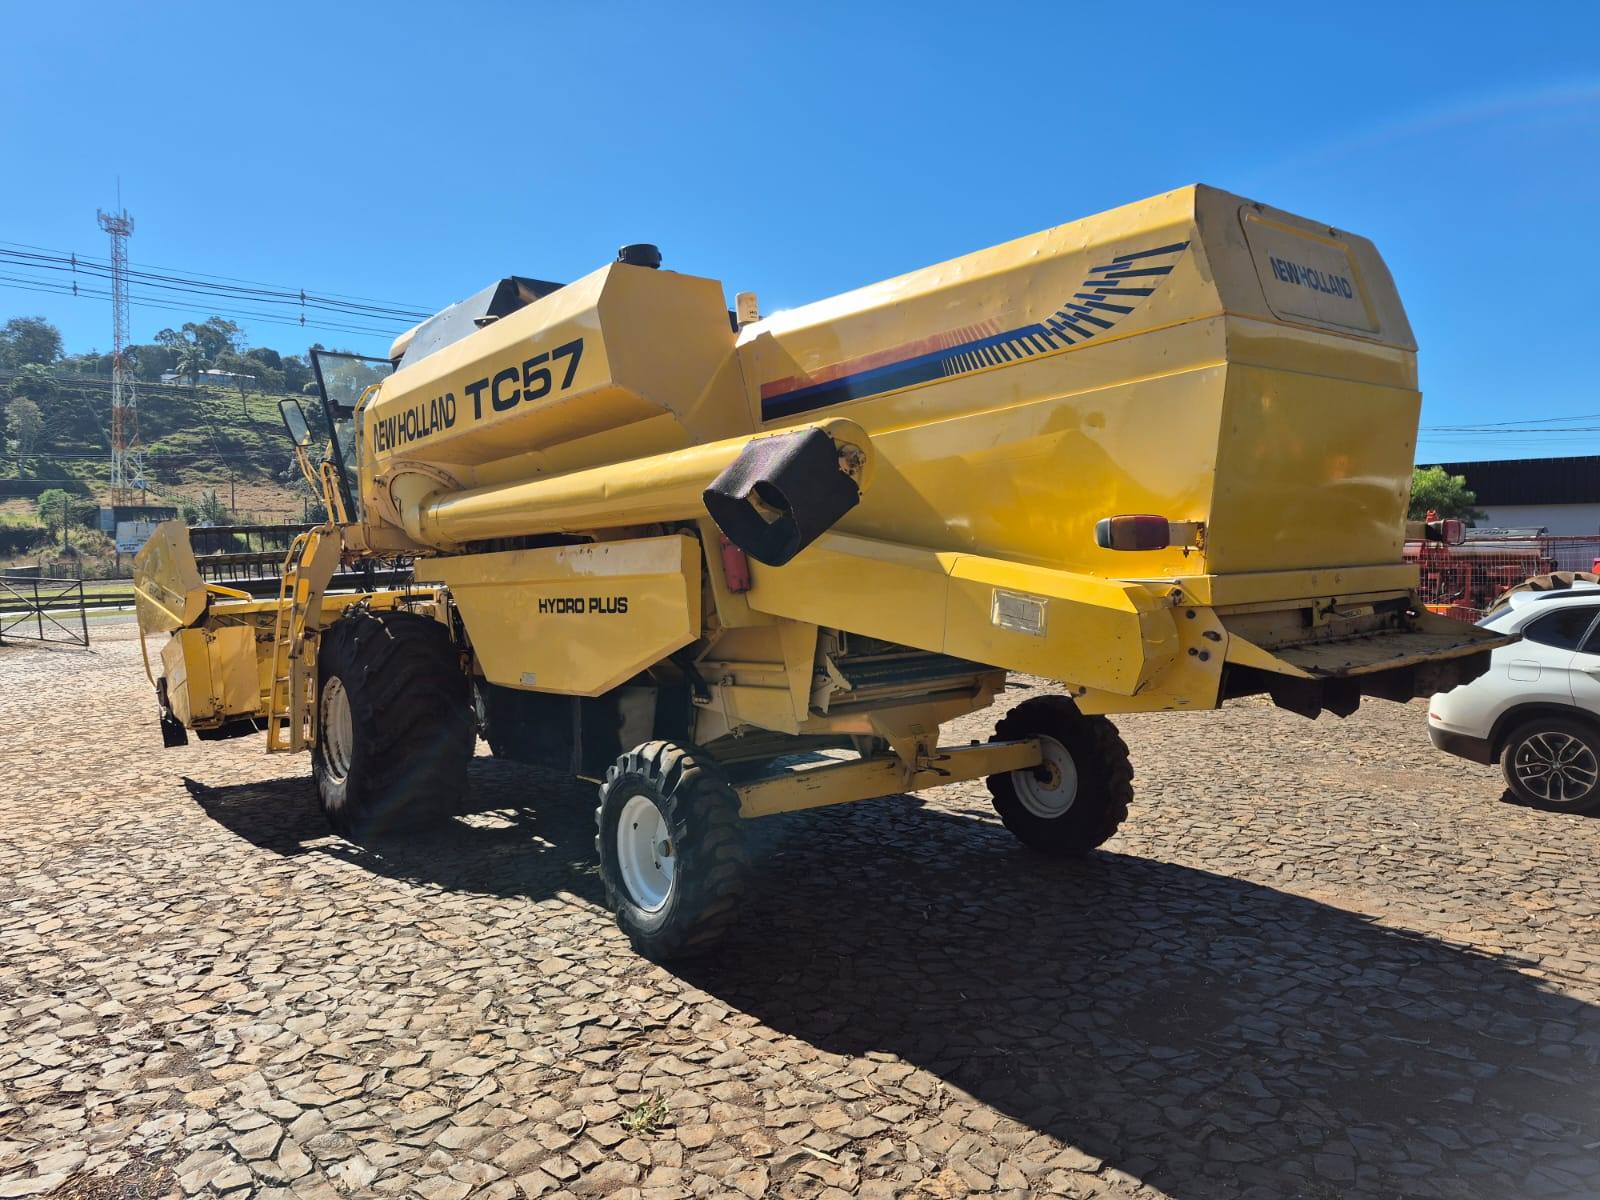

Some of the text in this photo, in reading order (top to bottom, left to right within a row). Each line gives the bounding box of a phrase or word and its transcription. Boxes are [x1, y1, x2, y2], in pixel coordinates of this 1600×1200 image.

[1270, 256, 1353, 299] NEW HOLLAND
[373, 338, 584, 454] NEW HOLLAND TC57
[538, 597, 629, 614] HYDRO PLUS
